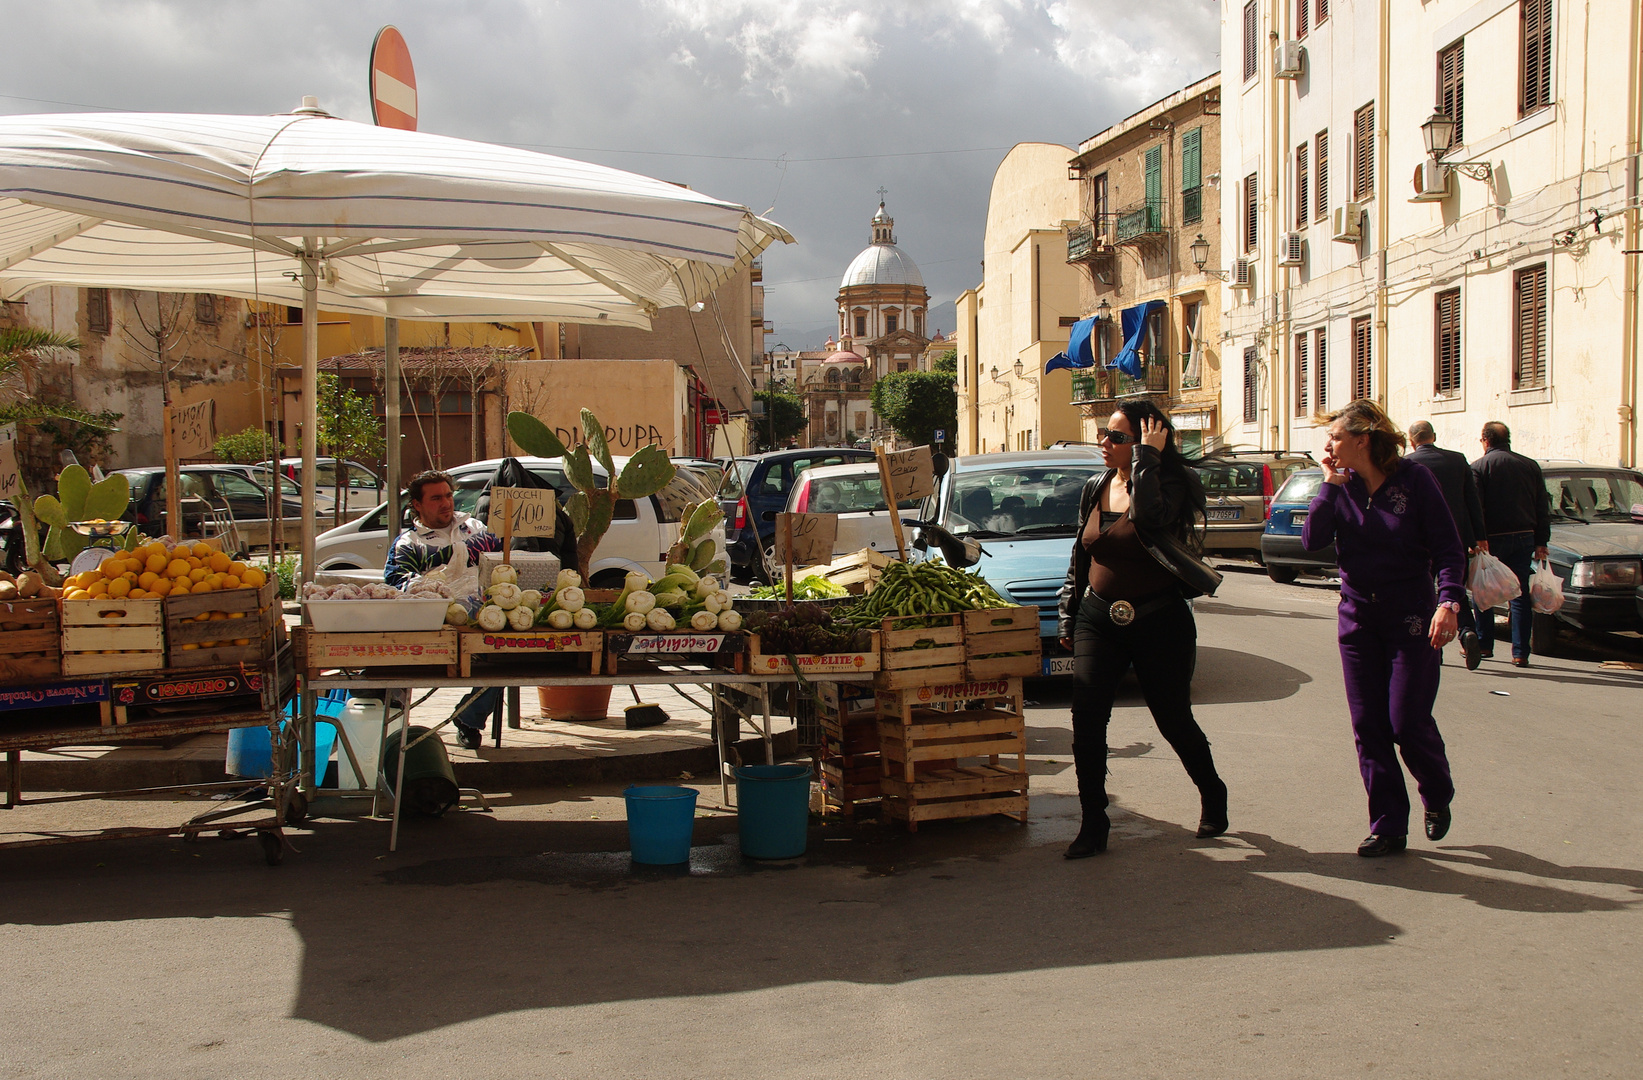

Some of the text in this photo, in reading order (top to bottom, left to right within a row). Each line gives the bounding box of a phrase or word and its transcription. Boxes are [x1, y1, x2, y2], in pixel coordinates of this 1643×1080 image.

[605, 424, 663, 449] PUPA
[936, 430, 943, 439] P
[887, 449, 918, 467] AVE
[496, 488, 542, 500] FINOCCHI
[906, 476, 919, 496] 1
[493, 503, 506, 520] €
[793, 514, 819, 537] 10
[805, 539, 818, 561] 1
[483, 634, 582, 651] La Fazenda
[821, 655, 853, 665] ELITE
[45, 686, 87, 699] Nuova
[87, 684, 105, 696] La
[158, 679, 228, 697] ORTAGGI
